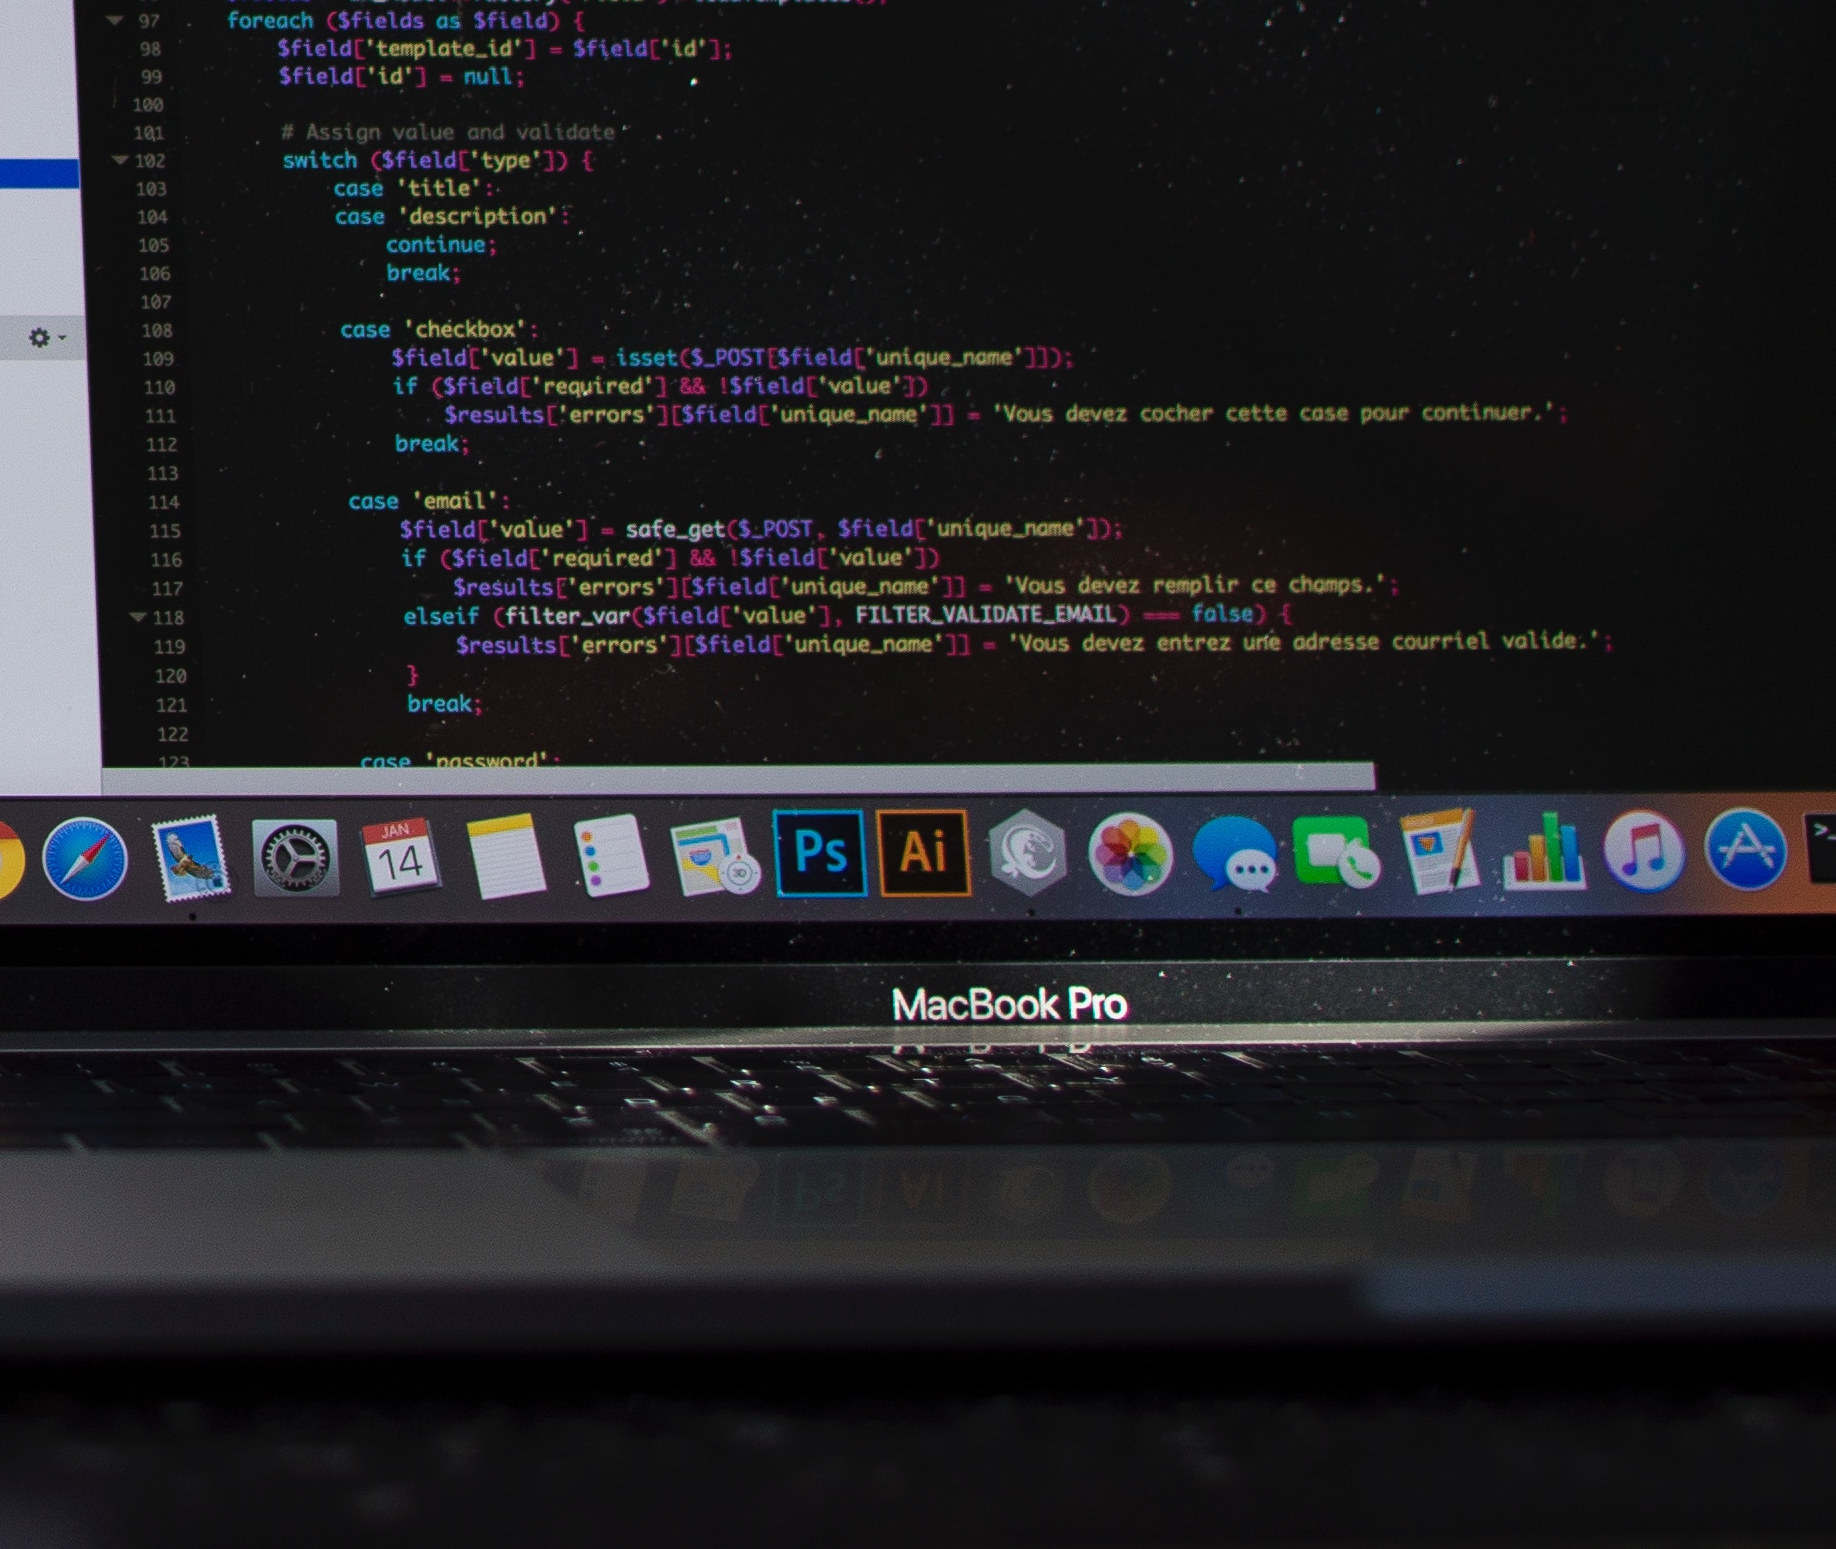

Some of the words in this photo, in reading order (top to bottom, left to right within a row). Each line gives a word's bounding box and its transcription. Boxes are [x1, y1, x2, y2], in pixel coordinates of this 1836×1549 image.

[227, 11, 315, 29] foreach
[435, 16, 463, 30] as
[307, 124, 380, 144] Assign
[394, 123, 454, 140] value
[468, 125, 505, 139] and
[518, 123, 614, 140] validate
[284, 151, 358, 169] switch
[334, 183, 384, 197] case
[335, 211, 385, 225] case
[341, 324, 391, 338] case
[394, 376, 417, 395] if
[1066, 405, 1127, 422] devez
[1140, 405, 1213, 422] cocher
[1226, 406, 1287, 421] cette
[1300, 408, 1349, 421] case
[1361, 408, 1409, 423] pour
[349, 496, 399, 510] case
[403, 548, 426, 567] if
[1078, 576, 1140, 594] devez
[1154, 575, 1239, 596] remplir
[1252, 579, 1277, 593] ce
[404, 606, 479, 626] elseif
[1082, 634, 1145, 652] devez
[1157, 635, 1231, 651] entrez
[1243, 635, 1282, 651] une
[1293, 633, 1380, 650] adresse
[1393, 631, 1489, 650] courriel
[381, 822, 410, 839] JAN
[795, 829, 849, 873] Ps
[900, 829, 946, 873] Ai
[378, 845, 423, 880] 14
[892, 986, 1062, 1021] MacBook
[1068, 985, 1129, 1021] Pro
